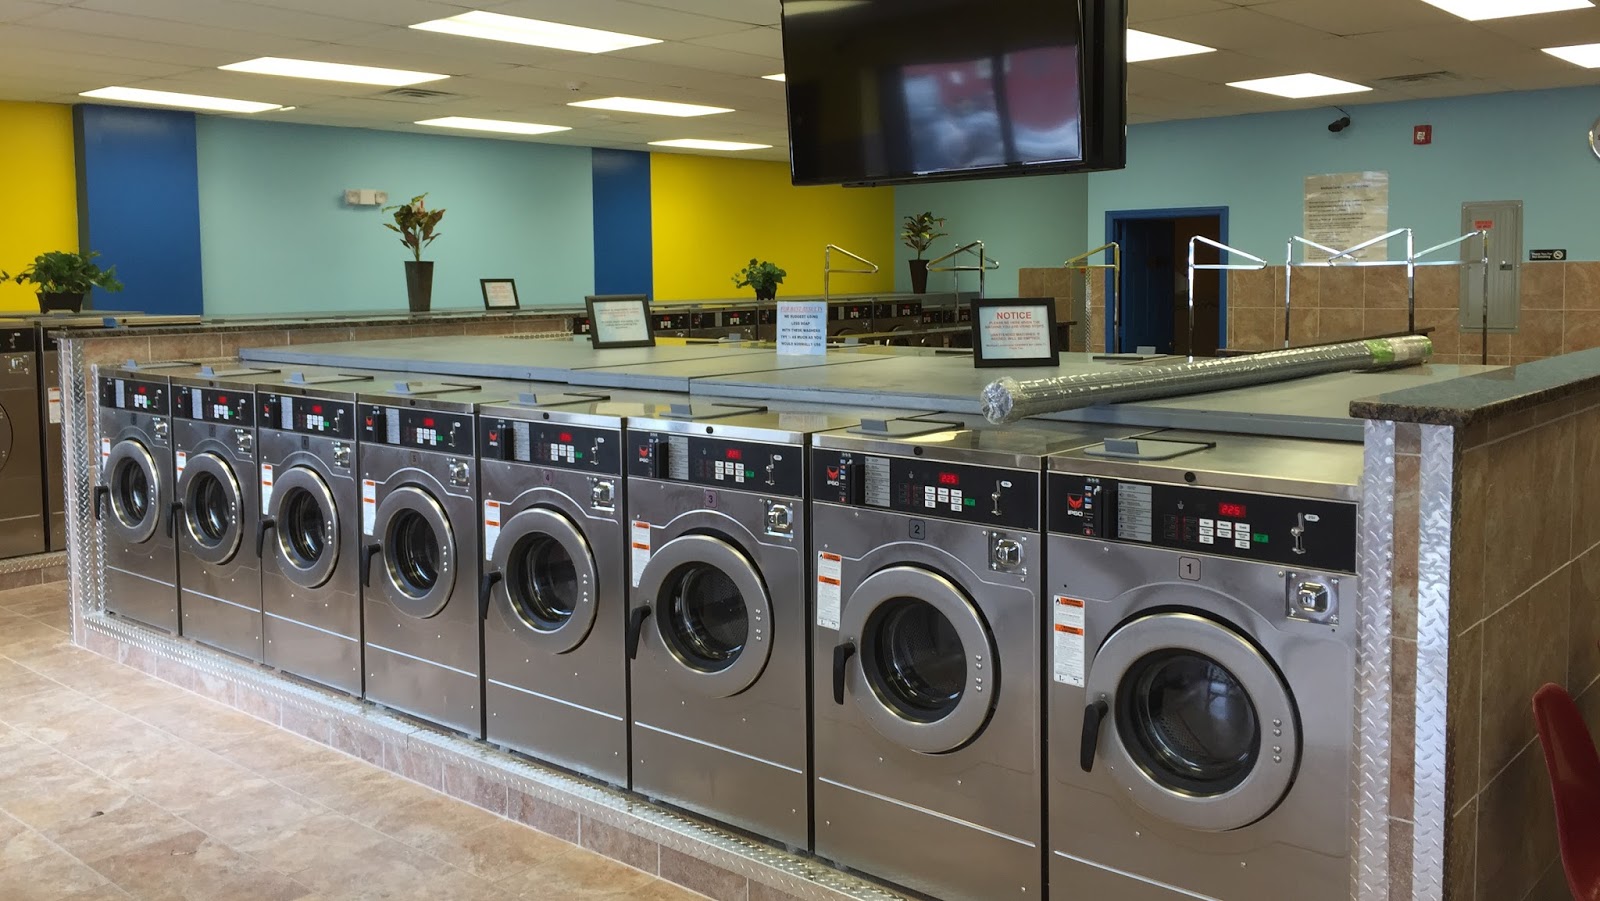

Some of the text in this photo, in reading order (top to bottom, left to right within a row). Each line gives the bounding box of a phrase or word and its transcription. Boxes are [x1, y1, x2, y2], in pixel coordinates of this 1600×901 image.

[708, 495, 713, 503] 3
[1222, 505, 1240, 515] 225
[914, 524, 920, 534] 2
[1186, 563, 1192, 574] 1
